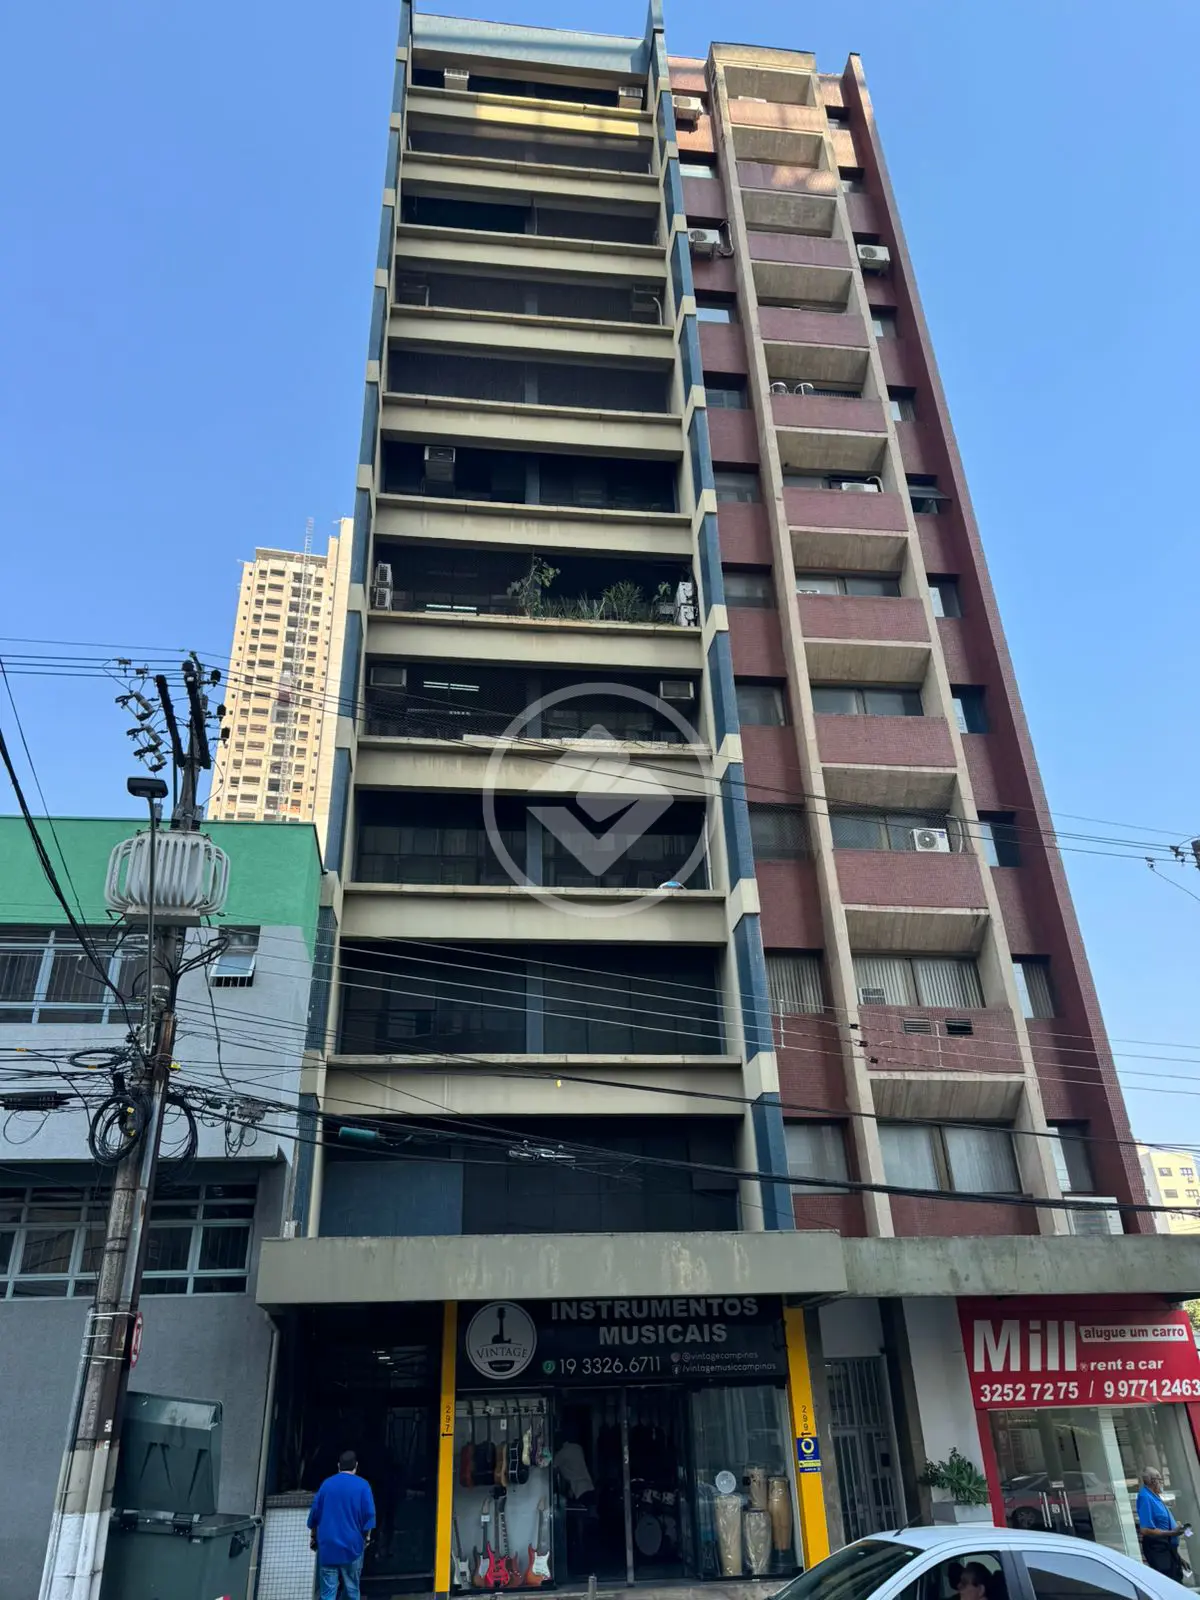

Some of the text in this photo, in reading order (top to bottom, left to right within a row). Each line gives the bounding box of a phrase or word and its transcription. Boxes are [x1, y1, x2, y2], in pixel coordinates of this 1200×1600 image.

[552, 1297, 759, 1320] INSTRUMENTOS
[599, 1323, 727, 1345] MUSICAIS
[1084, 1326, 1184, 1340] alugue um carro
[476, 1346, 528, 1359] VINTAGE
[973, 1319, 1077, 1373] Mill
[559, 1355, 661, 1375] 19 3326.6711
[1090, 1359, 1164, 1371] rent a car
[980, 1383, 1026, 1402] 3252
[1030, 1381, 1079, 1400] 7275
